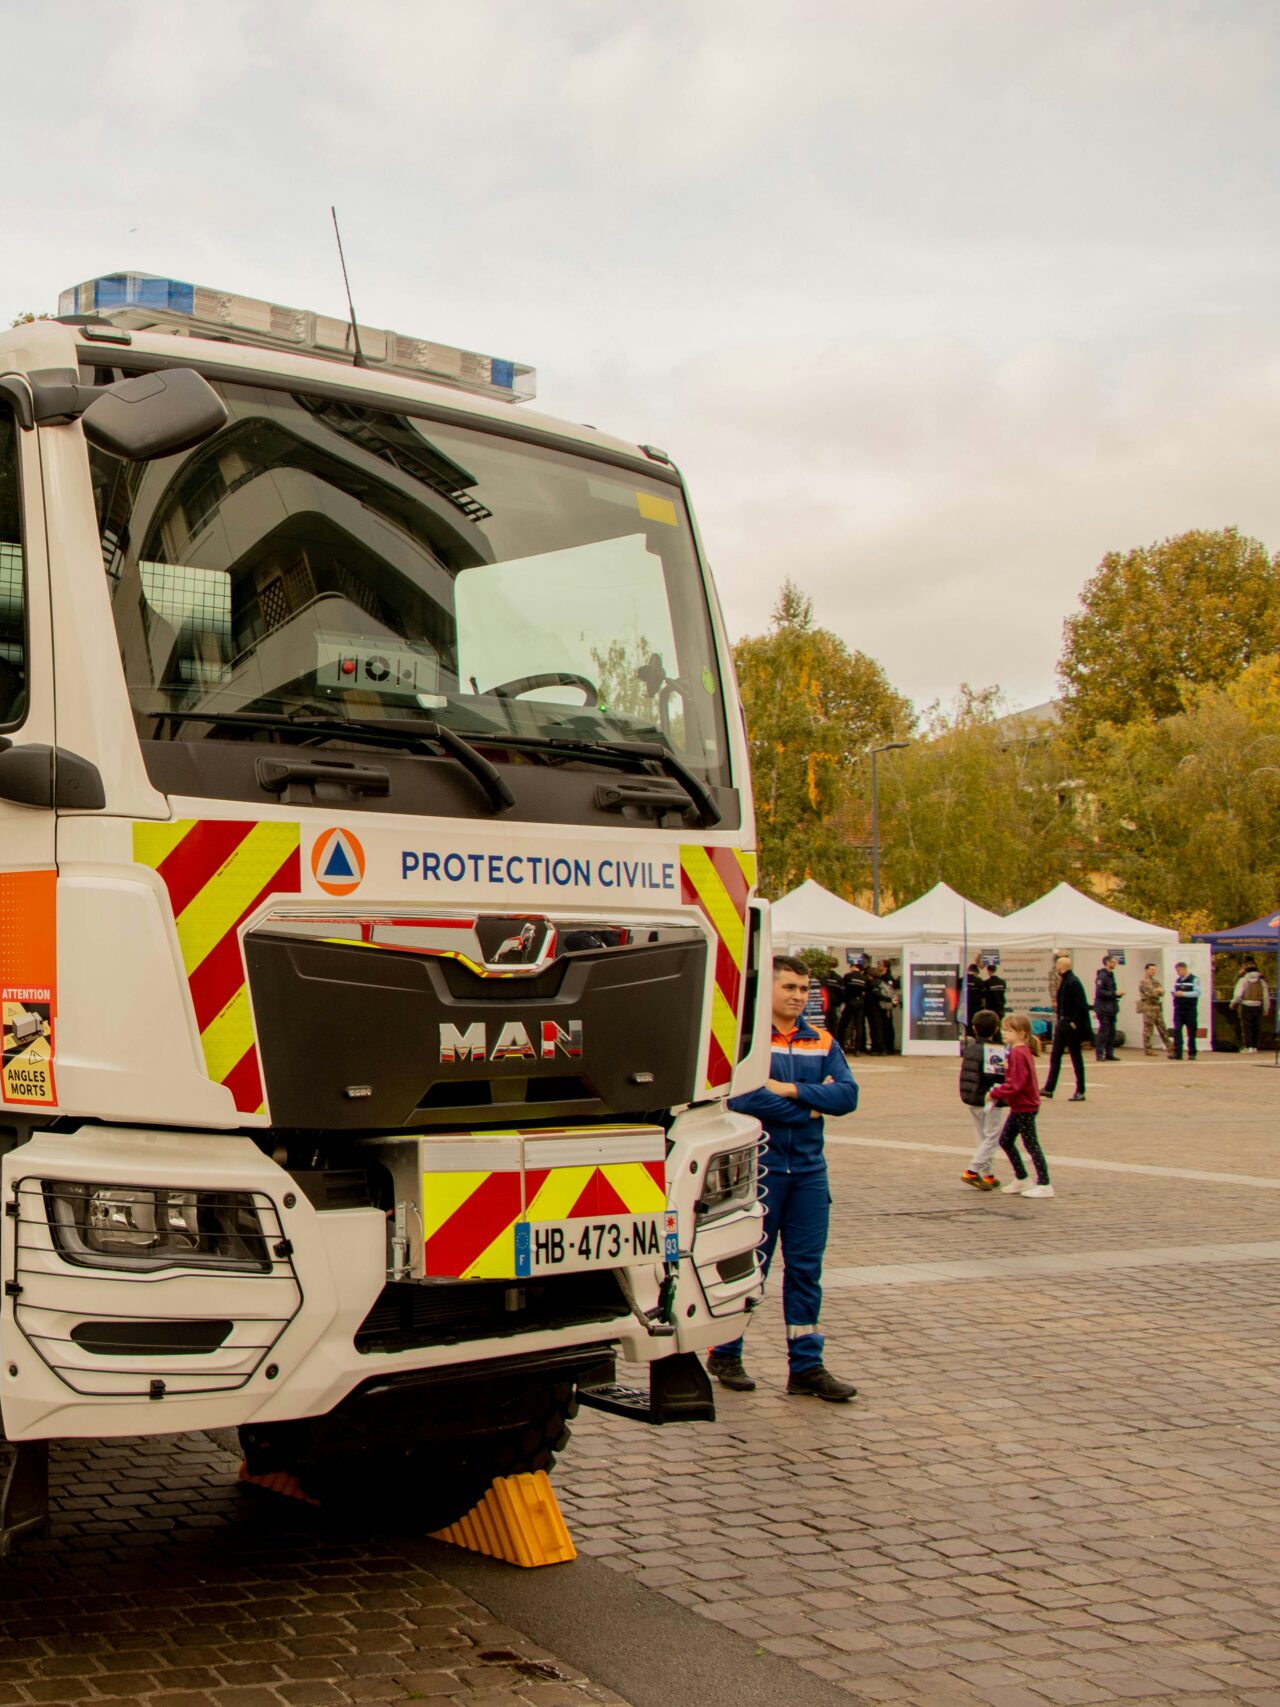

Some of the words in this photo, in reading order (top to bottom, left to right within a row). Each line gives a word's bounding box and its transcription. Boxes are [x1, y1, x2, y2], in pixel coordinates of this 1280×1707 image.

[401, 851, 591, 887] PROTECTION
[598, 860, 675, 889] CIVILE
[2, 988, 50, 1000] ATTENTION
[439, 1019, 583, 1062] MAN
[7, 1069, 46, 1082] ANGLES
[11, 1083, 46, 1096] MORTS
[535, 1219, 660, 1265] HB-473-NA
[665, 1238, 677, 1254] 93
[519, 1254, 526, 1266] F
